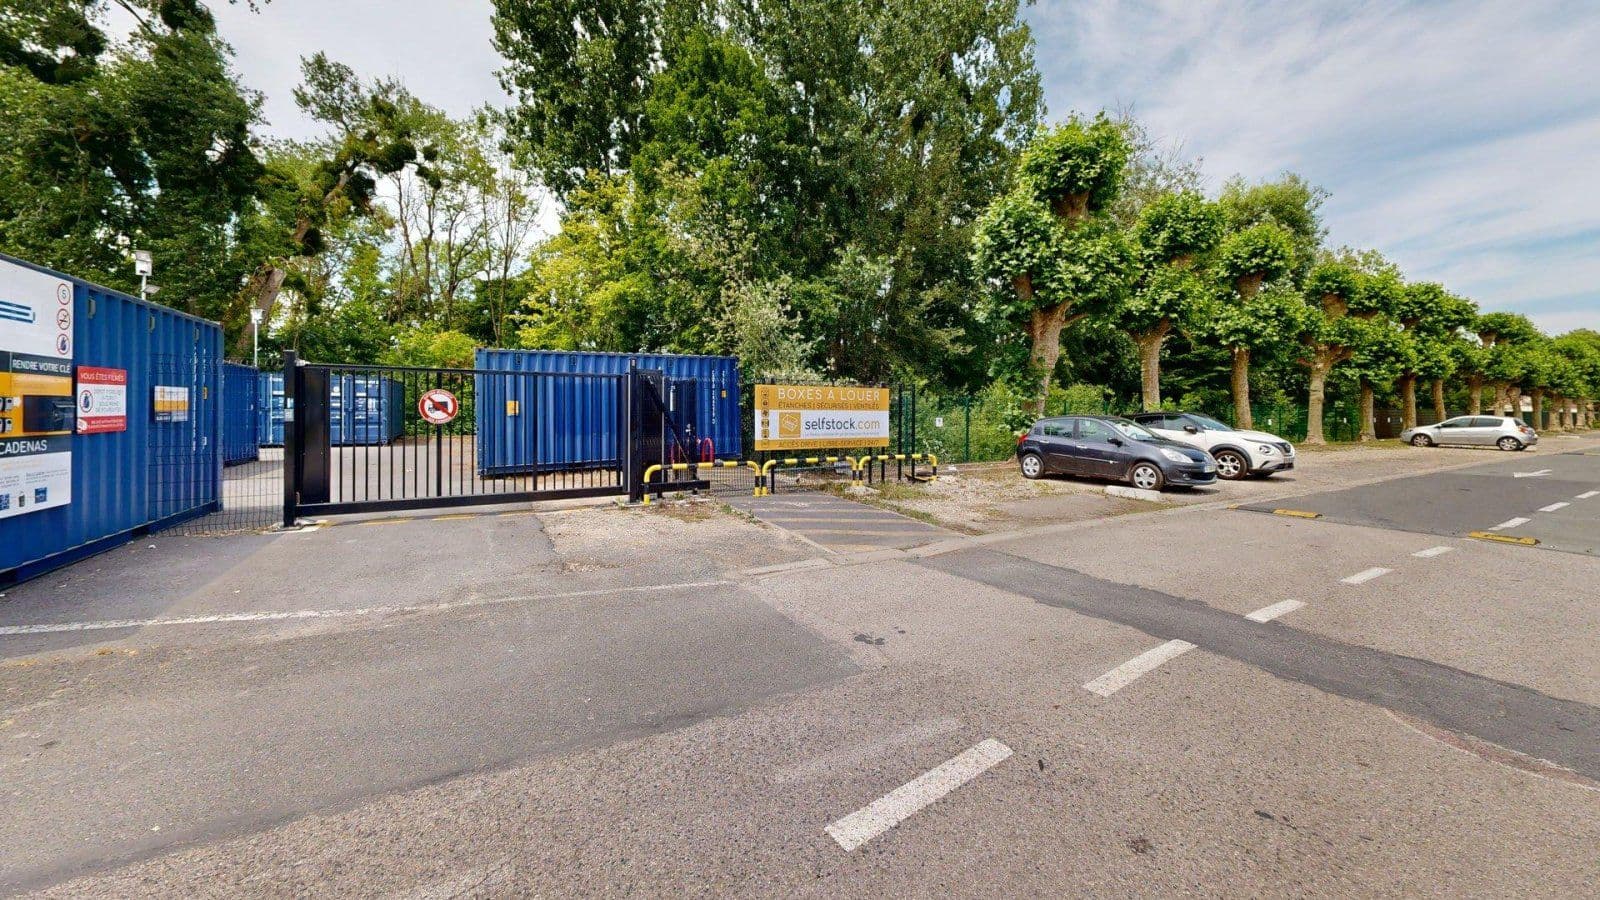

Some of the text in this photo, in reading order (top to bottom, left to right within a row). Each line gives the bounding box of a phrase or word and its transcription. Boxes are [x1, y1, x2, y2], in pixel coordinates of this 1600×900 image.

[12, 359, 38, 370] RENDRE
[39, 362, 59, 372] VOTRE
[80, 372, 95, 380] VOUS
[778, 388, 822, 400] BOXES
[840, 390, 880, 401] LOUER
[804, 417, 880, 430] selfstock.com
[0, 439, 48, 455] CADENAS
